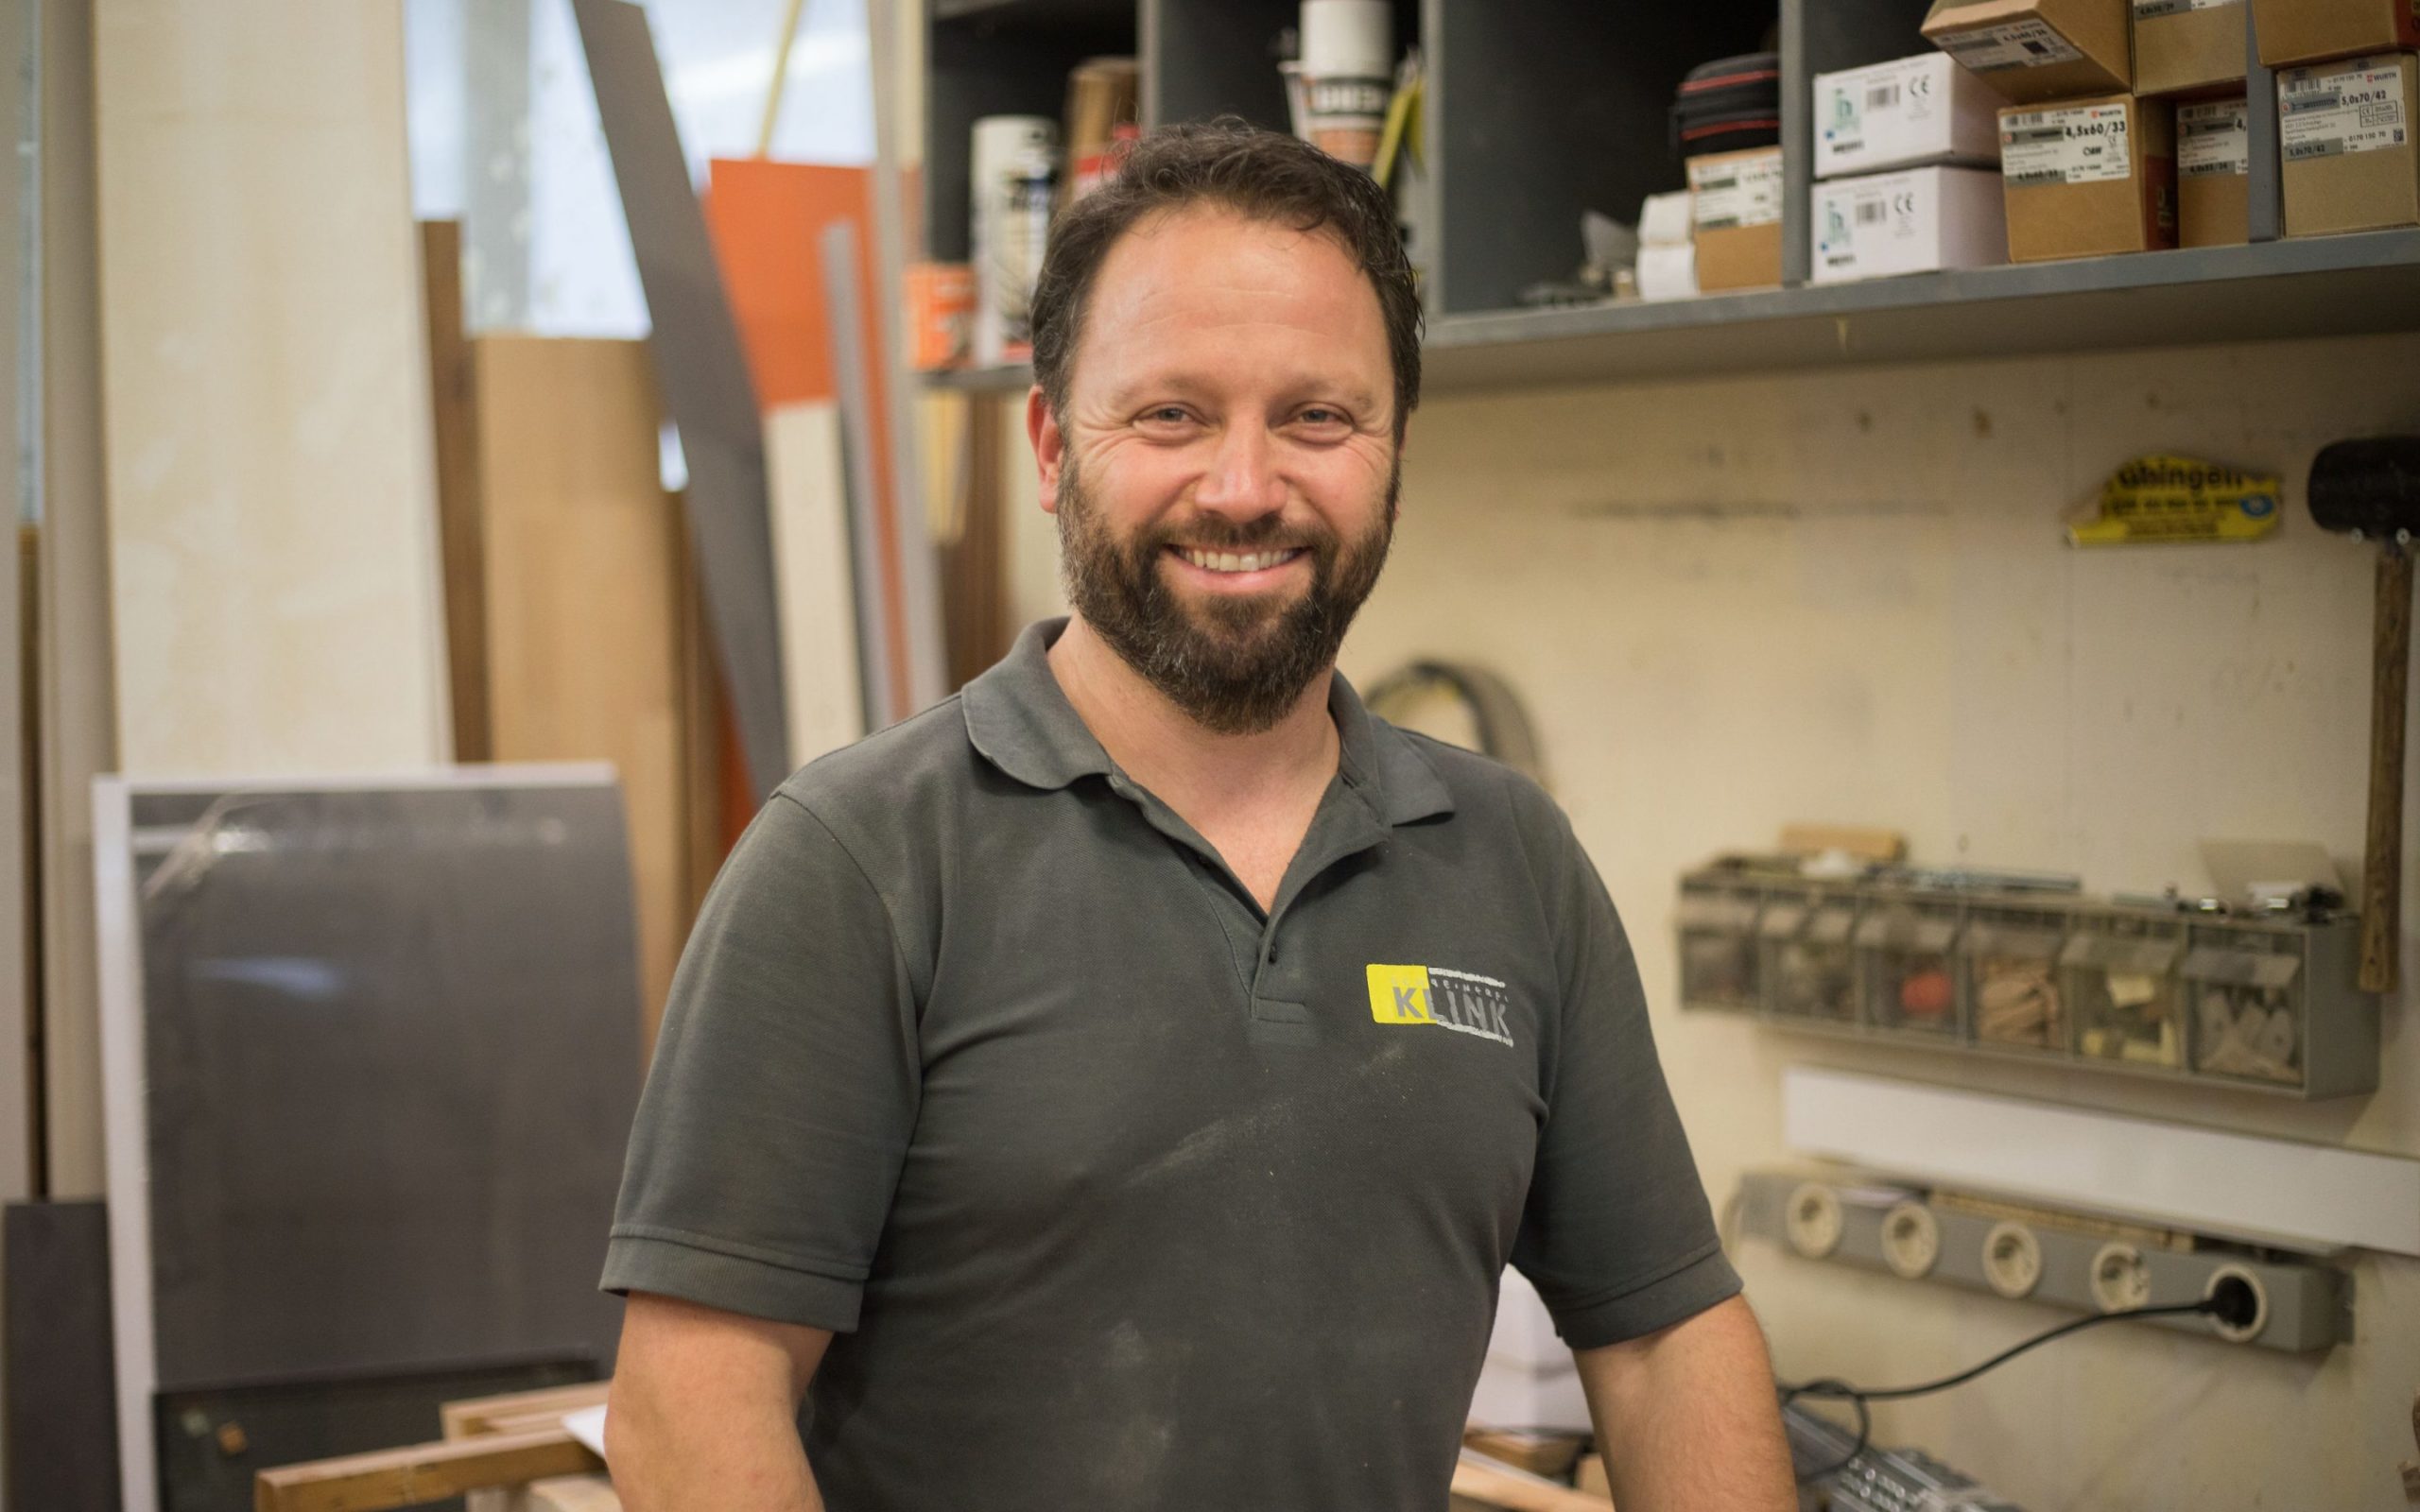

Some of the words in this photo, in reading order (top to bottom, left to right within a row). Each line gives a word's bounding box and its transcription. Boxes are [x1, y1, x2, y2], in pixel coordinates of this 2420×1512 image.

[2341, 90, 2387, 107] 5,0x70/42
[2065, 120, 2126, 140] 4,5x60/33
[1391, 975, 1510, 1003] REINEREI
[1392, 986, 1512, 1038] KLINK
